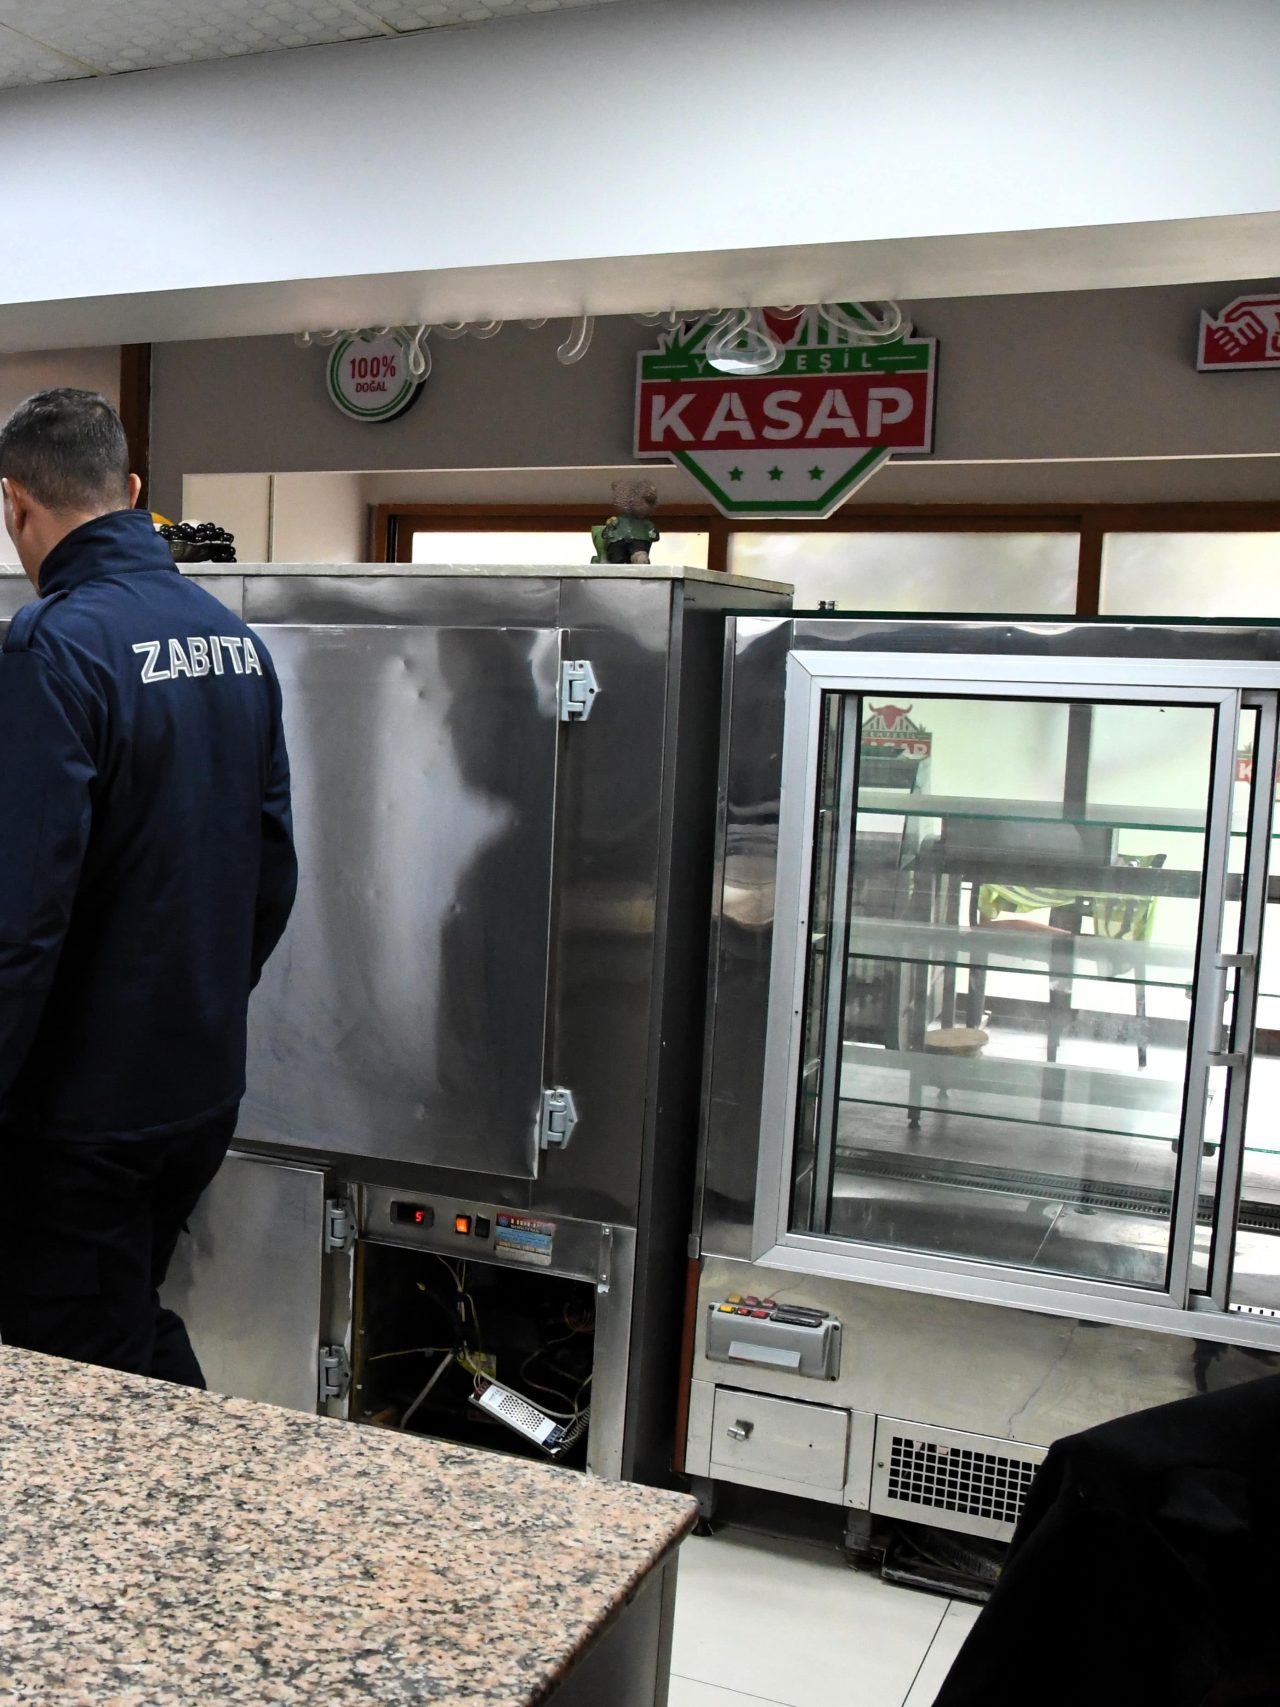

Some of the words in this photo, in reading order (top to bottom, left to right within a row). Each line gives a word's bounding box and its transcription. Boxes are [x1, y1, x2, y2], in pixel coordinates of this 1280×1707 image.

[350, 354, 396, 379] 100%
[355, 380, 388, 393] DOĞAL
[650, 386, 914, 442] KASAP
[131, 635, 263, 684] ZABITA
